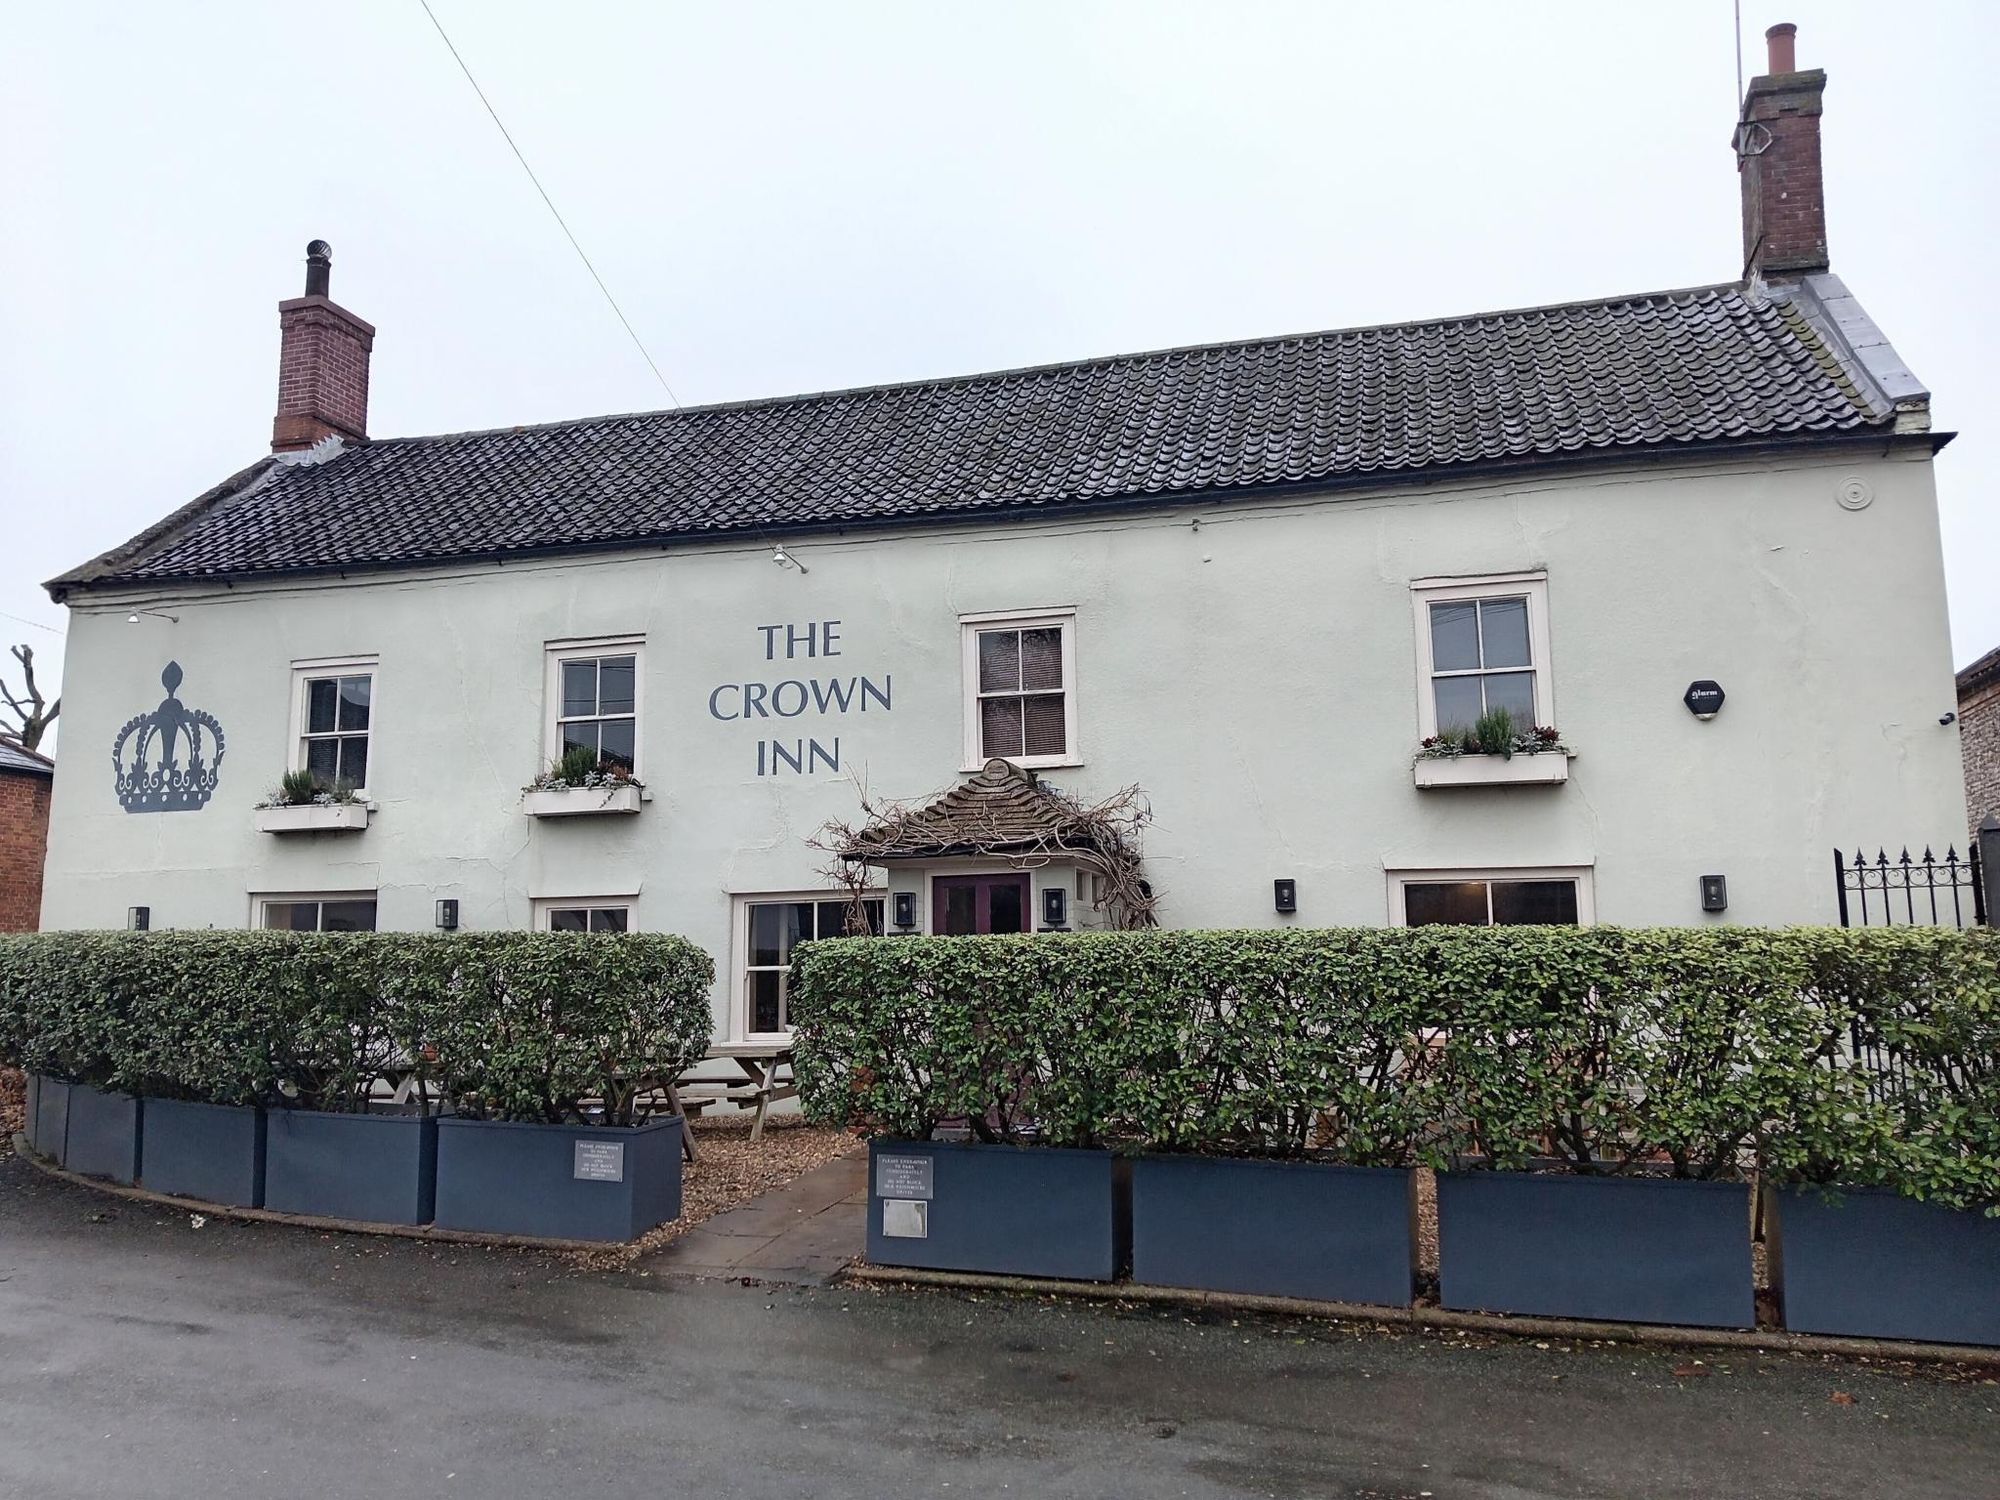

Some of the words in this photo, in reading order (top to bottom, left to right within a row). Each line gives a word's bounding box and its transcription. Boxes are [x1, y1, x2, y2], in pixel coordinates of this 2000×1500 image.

[758, 621, 842, 660] THE
[709, 675, 892, 720] CROWN
[757, 737, 840, 776] INN
